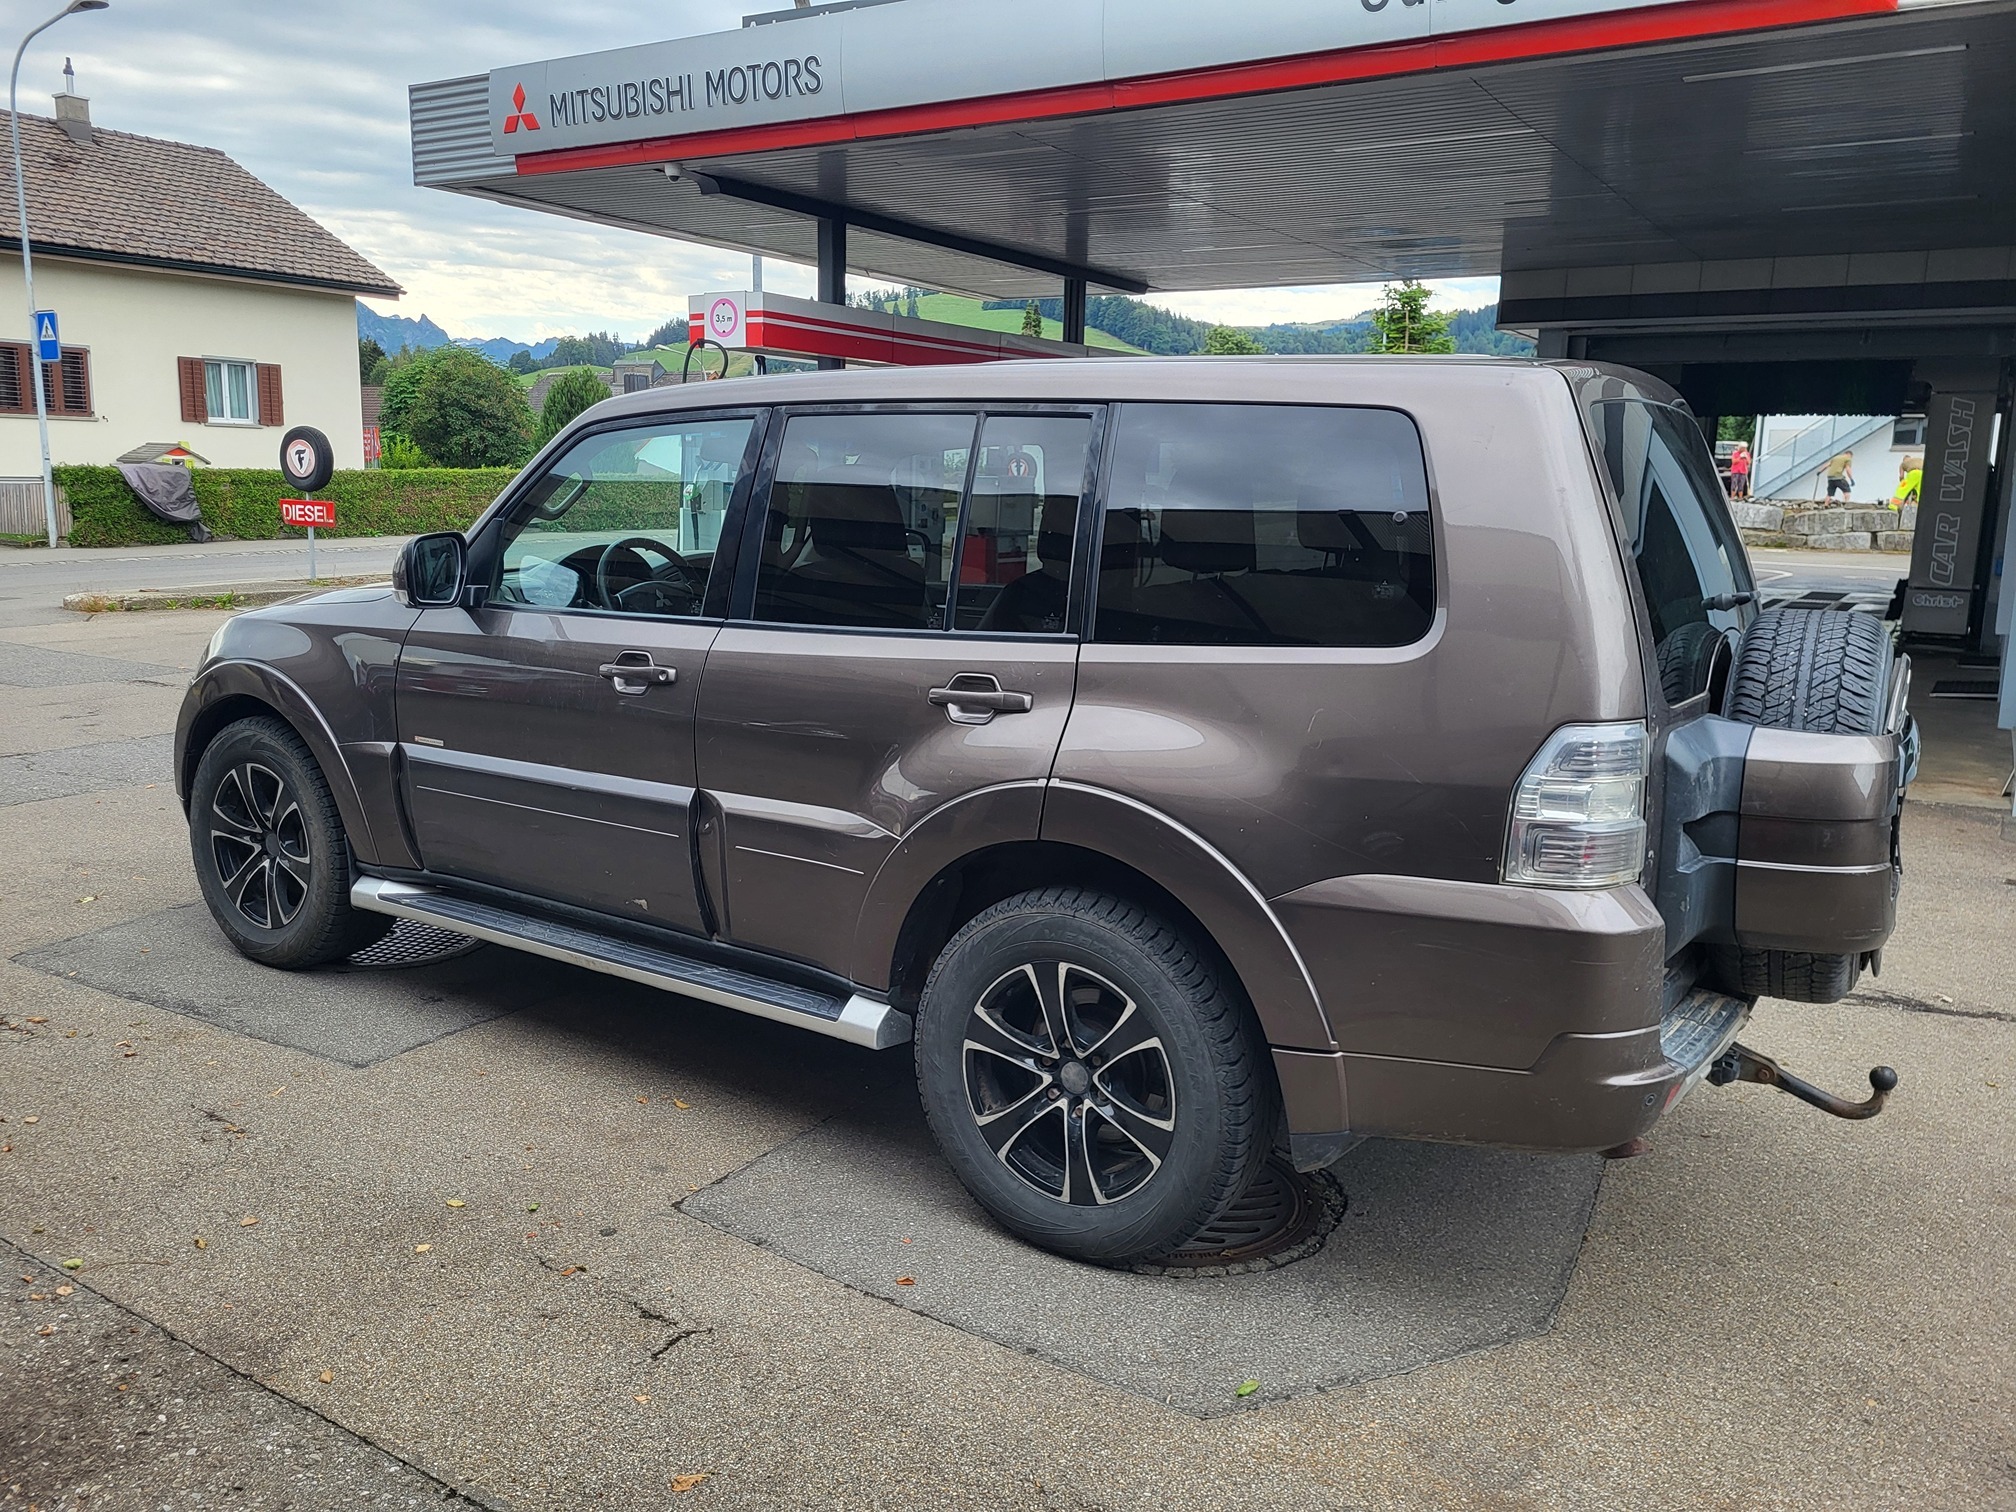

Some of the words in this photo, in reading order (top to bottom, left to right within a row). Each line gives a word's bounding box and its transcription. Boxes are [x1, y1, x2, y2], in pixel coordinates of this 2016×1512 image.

[549, 74, 695, 127] MITSUBISHI
[706, 56, 822, 106] MOTORS
[715, 313, 726, 324] 3,5
[1940, 398, 1974, 501] WASH
[283, 504, 333, 523] DIESEL
[1930, 514, 1960, 586] CAR
[1912, 594, 1963, 608] Christ
